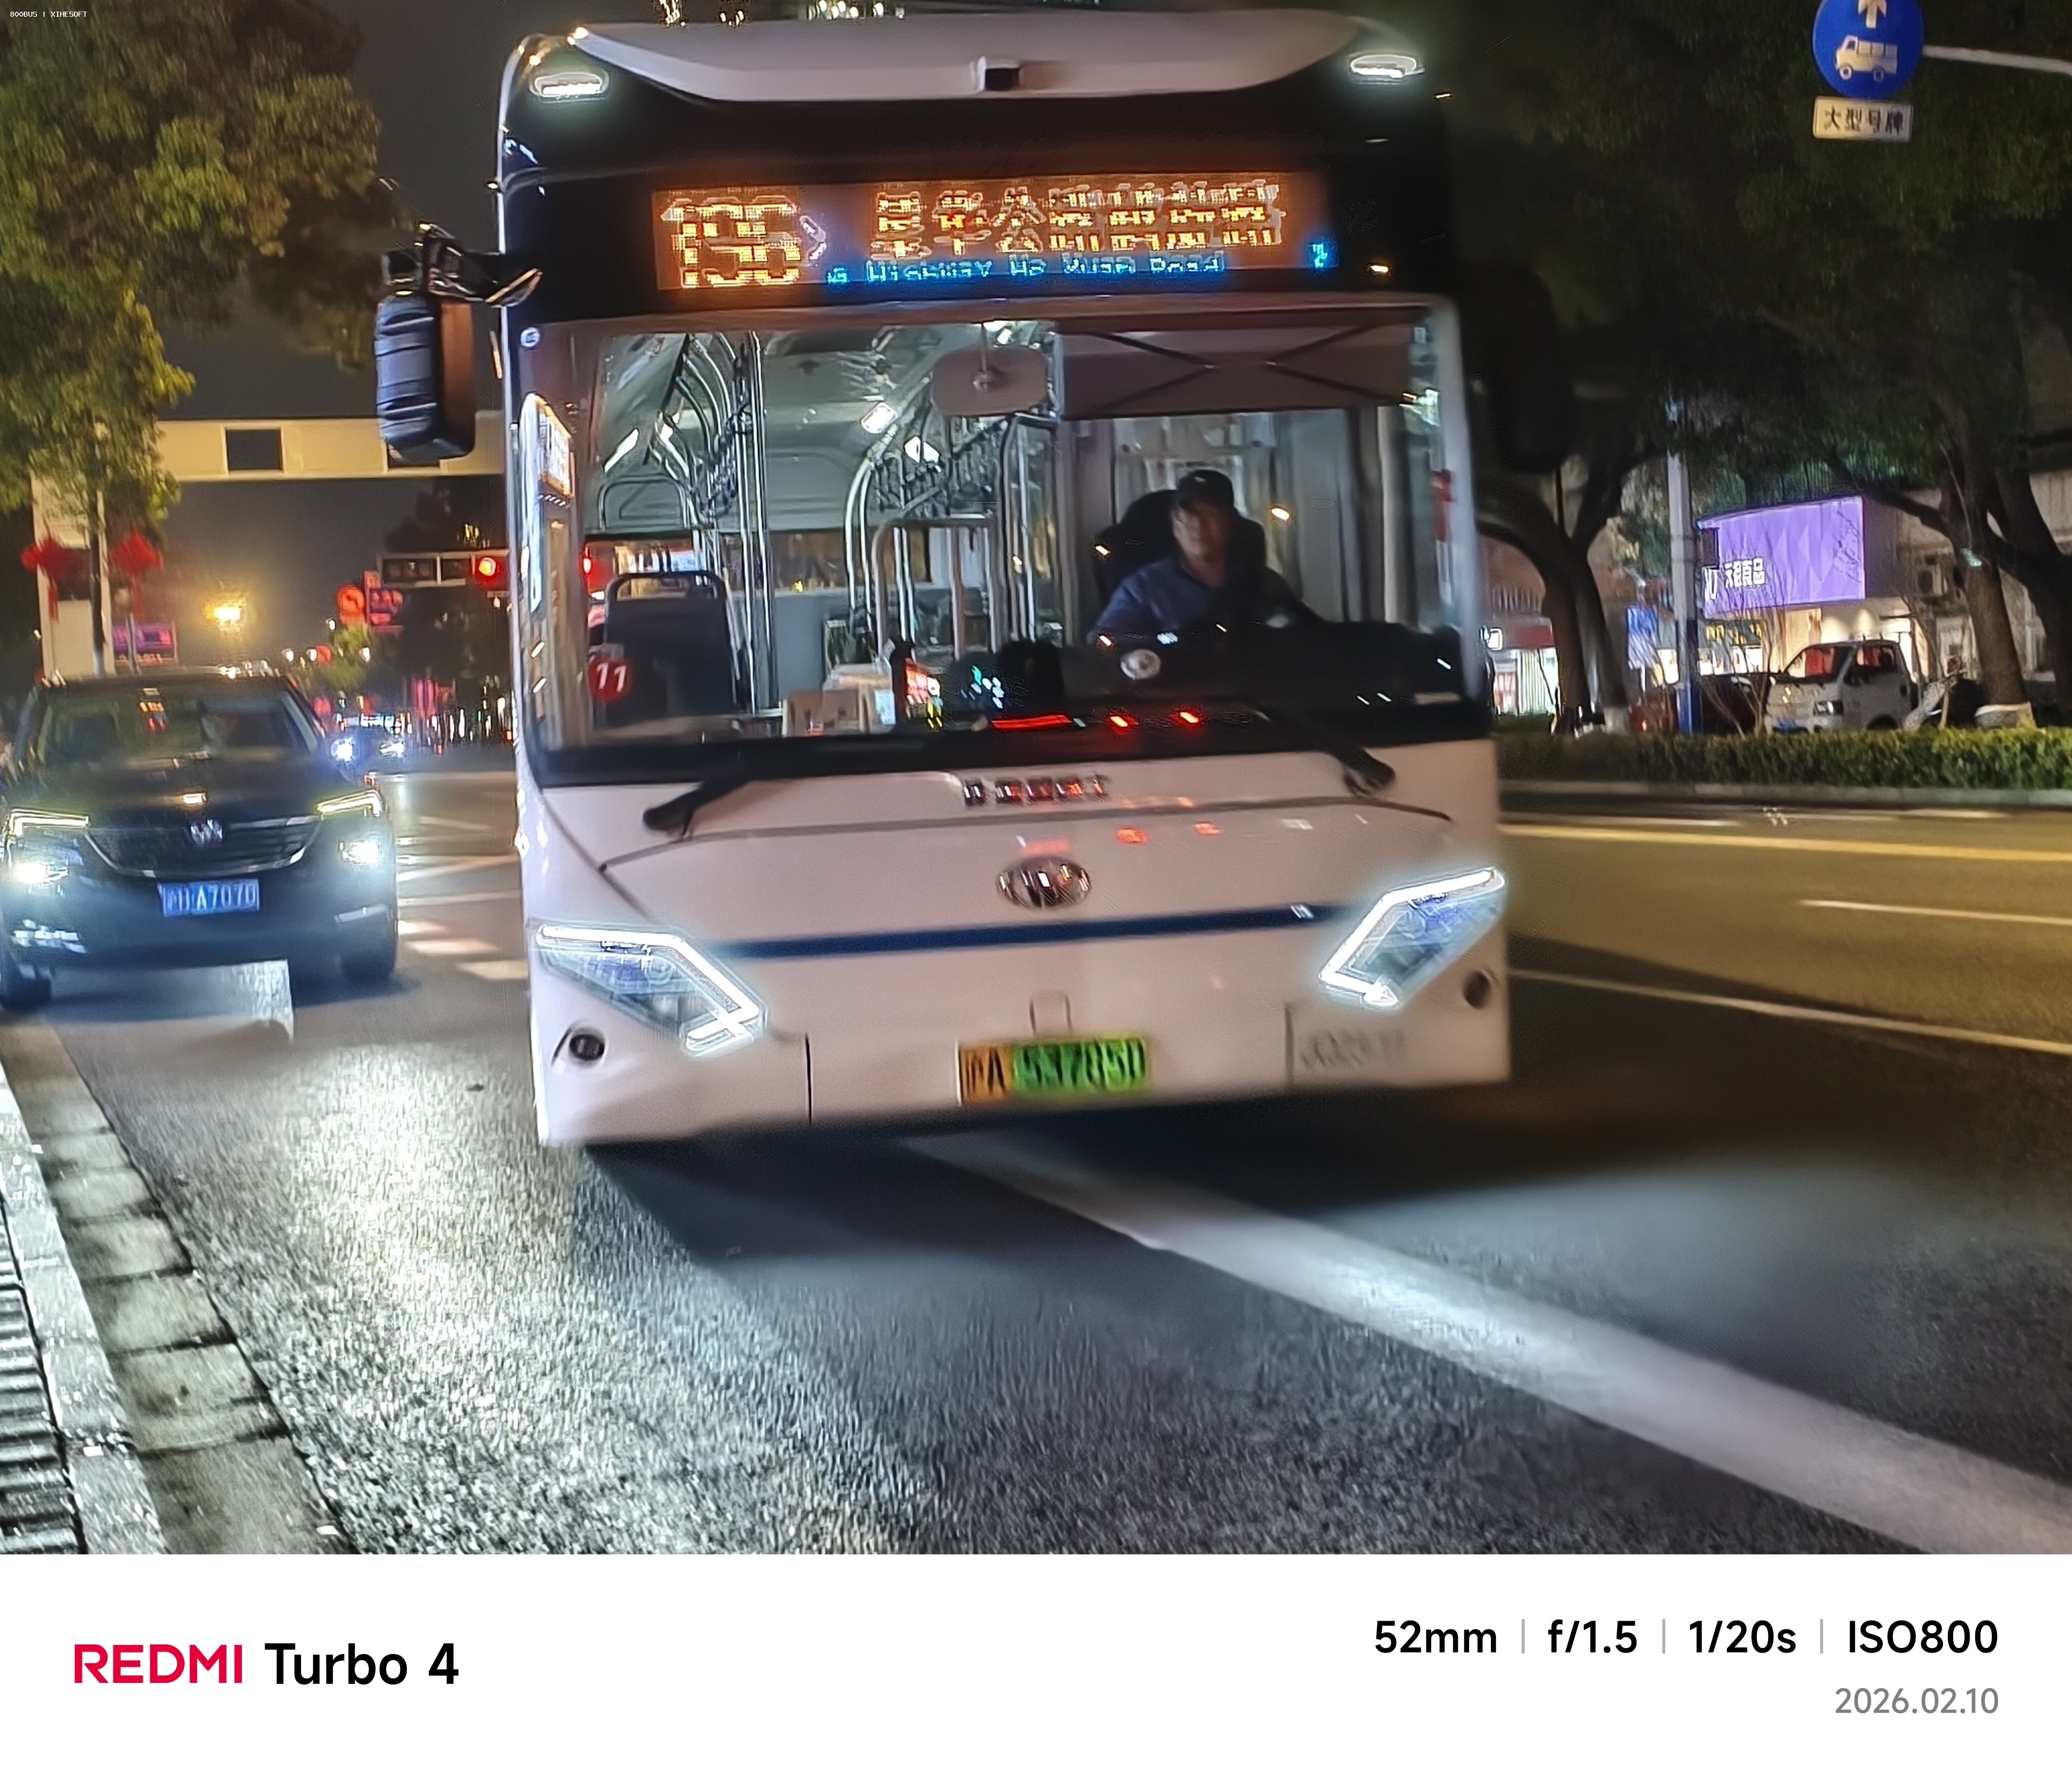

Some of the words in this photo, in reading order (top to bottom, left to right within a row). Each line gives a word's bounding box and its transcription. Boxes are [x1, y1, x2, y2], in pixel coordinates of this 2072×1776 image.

[1823, 104, 1904, 135] 大型号牌
[595, 662, 628, 694] 11
